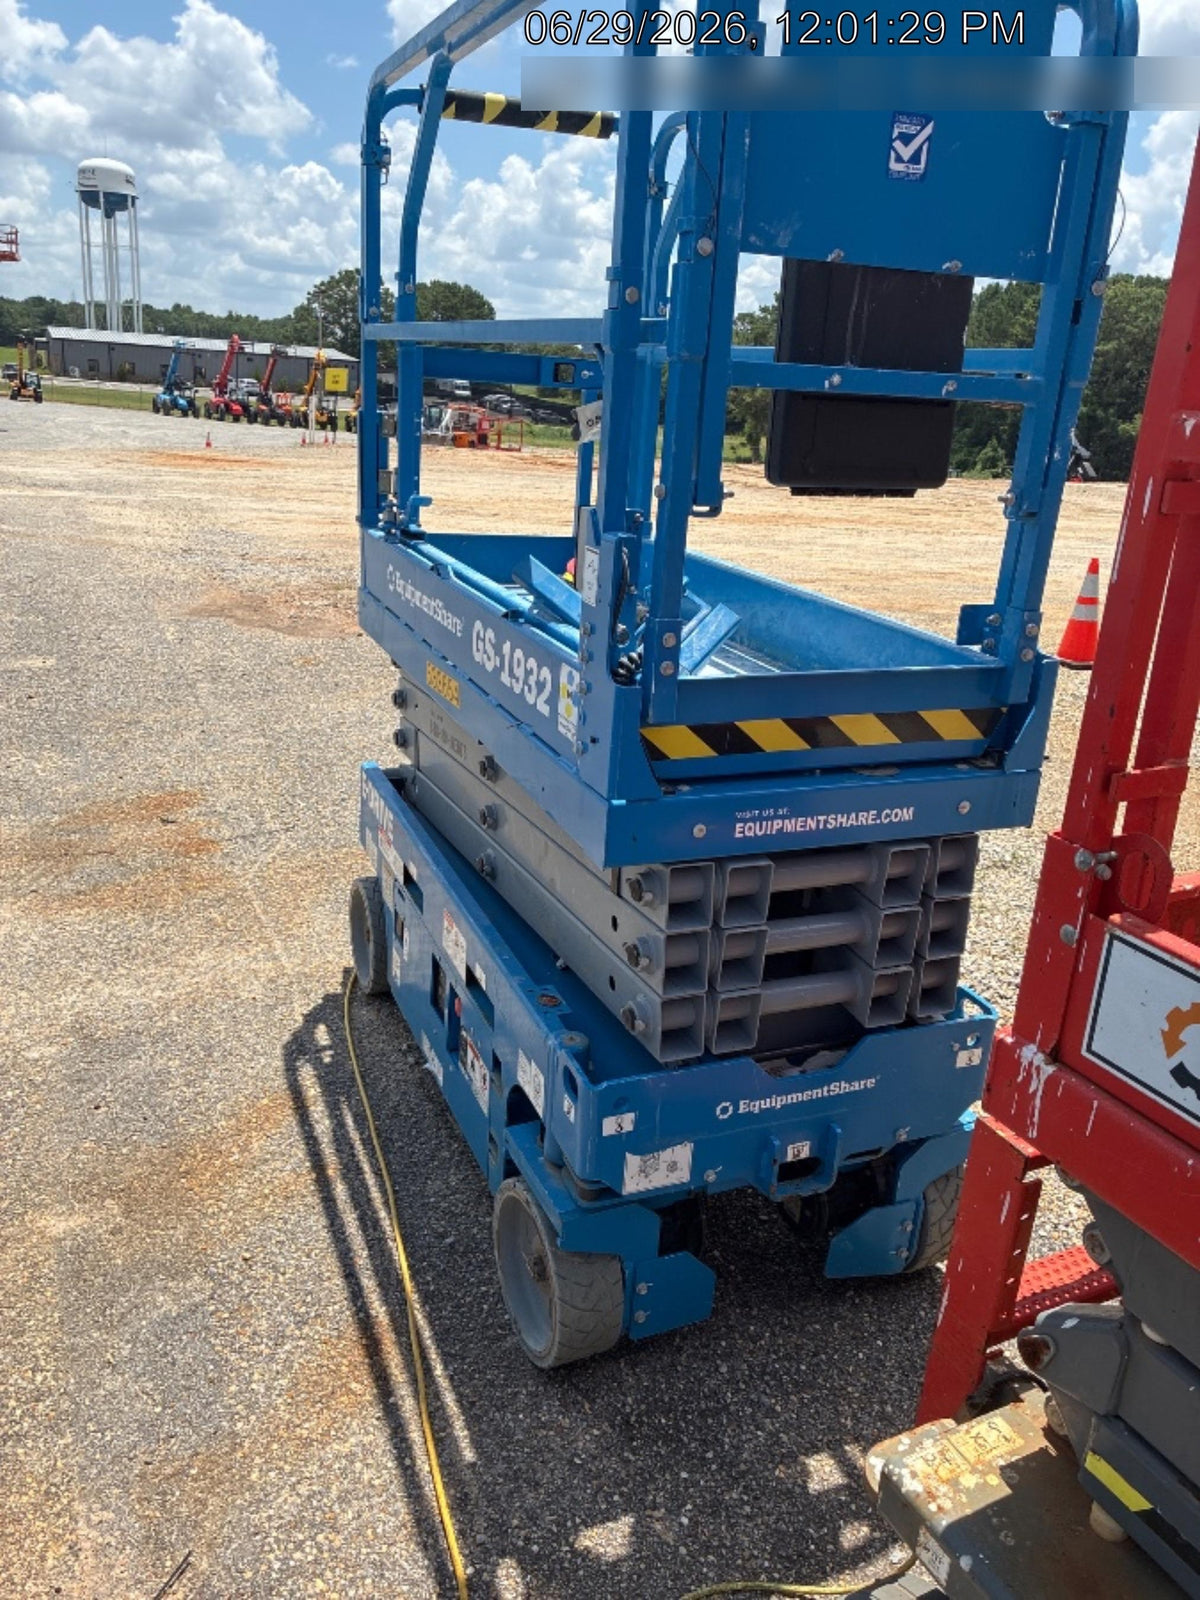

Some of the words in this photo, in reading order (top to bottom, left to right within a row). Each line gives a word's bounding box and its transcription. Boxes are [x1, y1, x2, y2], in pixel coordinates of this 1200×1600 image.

[472, 619, 553, 718] GS-1932
[734, 807, 915, 838] EQUIPMENTSHARE.COM
[737, 1075, 877, 1115] EquipmentShare
